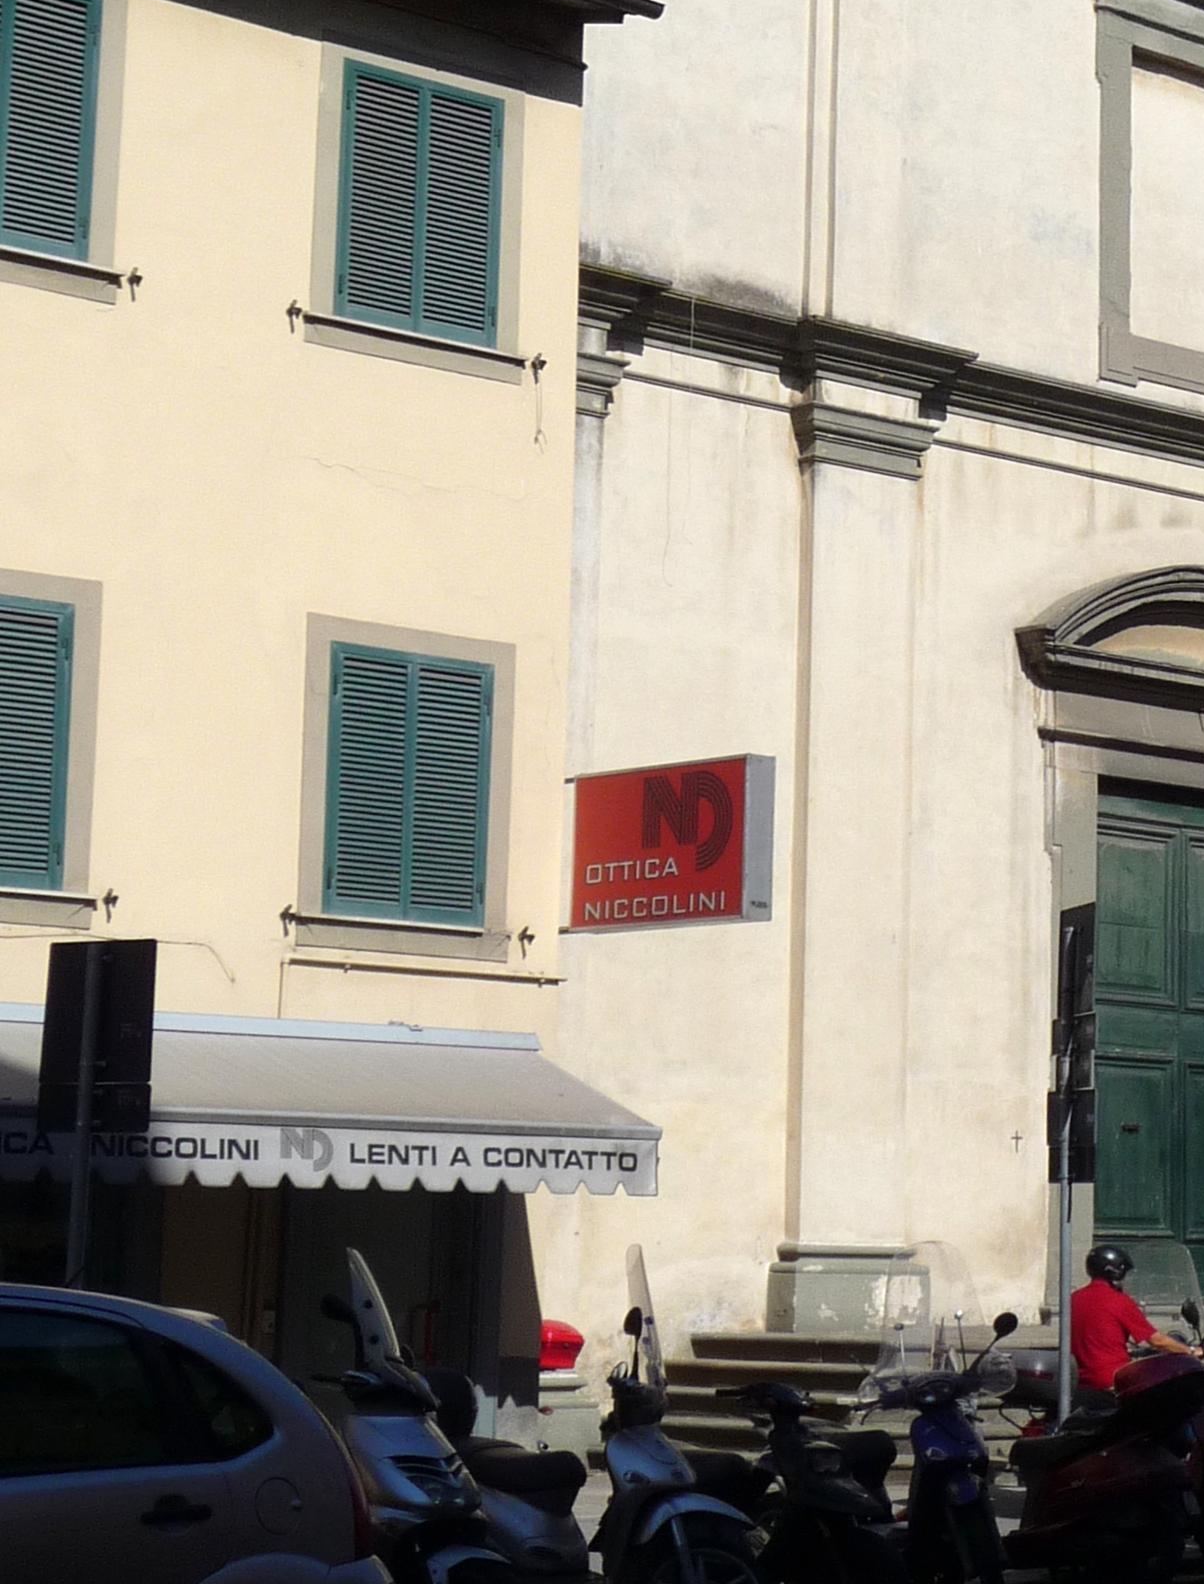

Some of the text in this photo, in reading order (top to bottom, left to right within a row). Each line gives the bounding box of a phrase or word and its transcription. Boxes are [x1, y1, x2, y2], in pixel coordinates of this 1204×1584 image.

[585, 857, 679, 884] OTTICA
[584, 891, 726, 921] NICCOLINI
[91, 1134, 259, 1161] NICCOLINI
[350, 1143, 437, 1166] LENTI
[450, 1146, 471, 1166] A
[483, 1147, 638, 1172] CONTATTO
